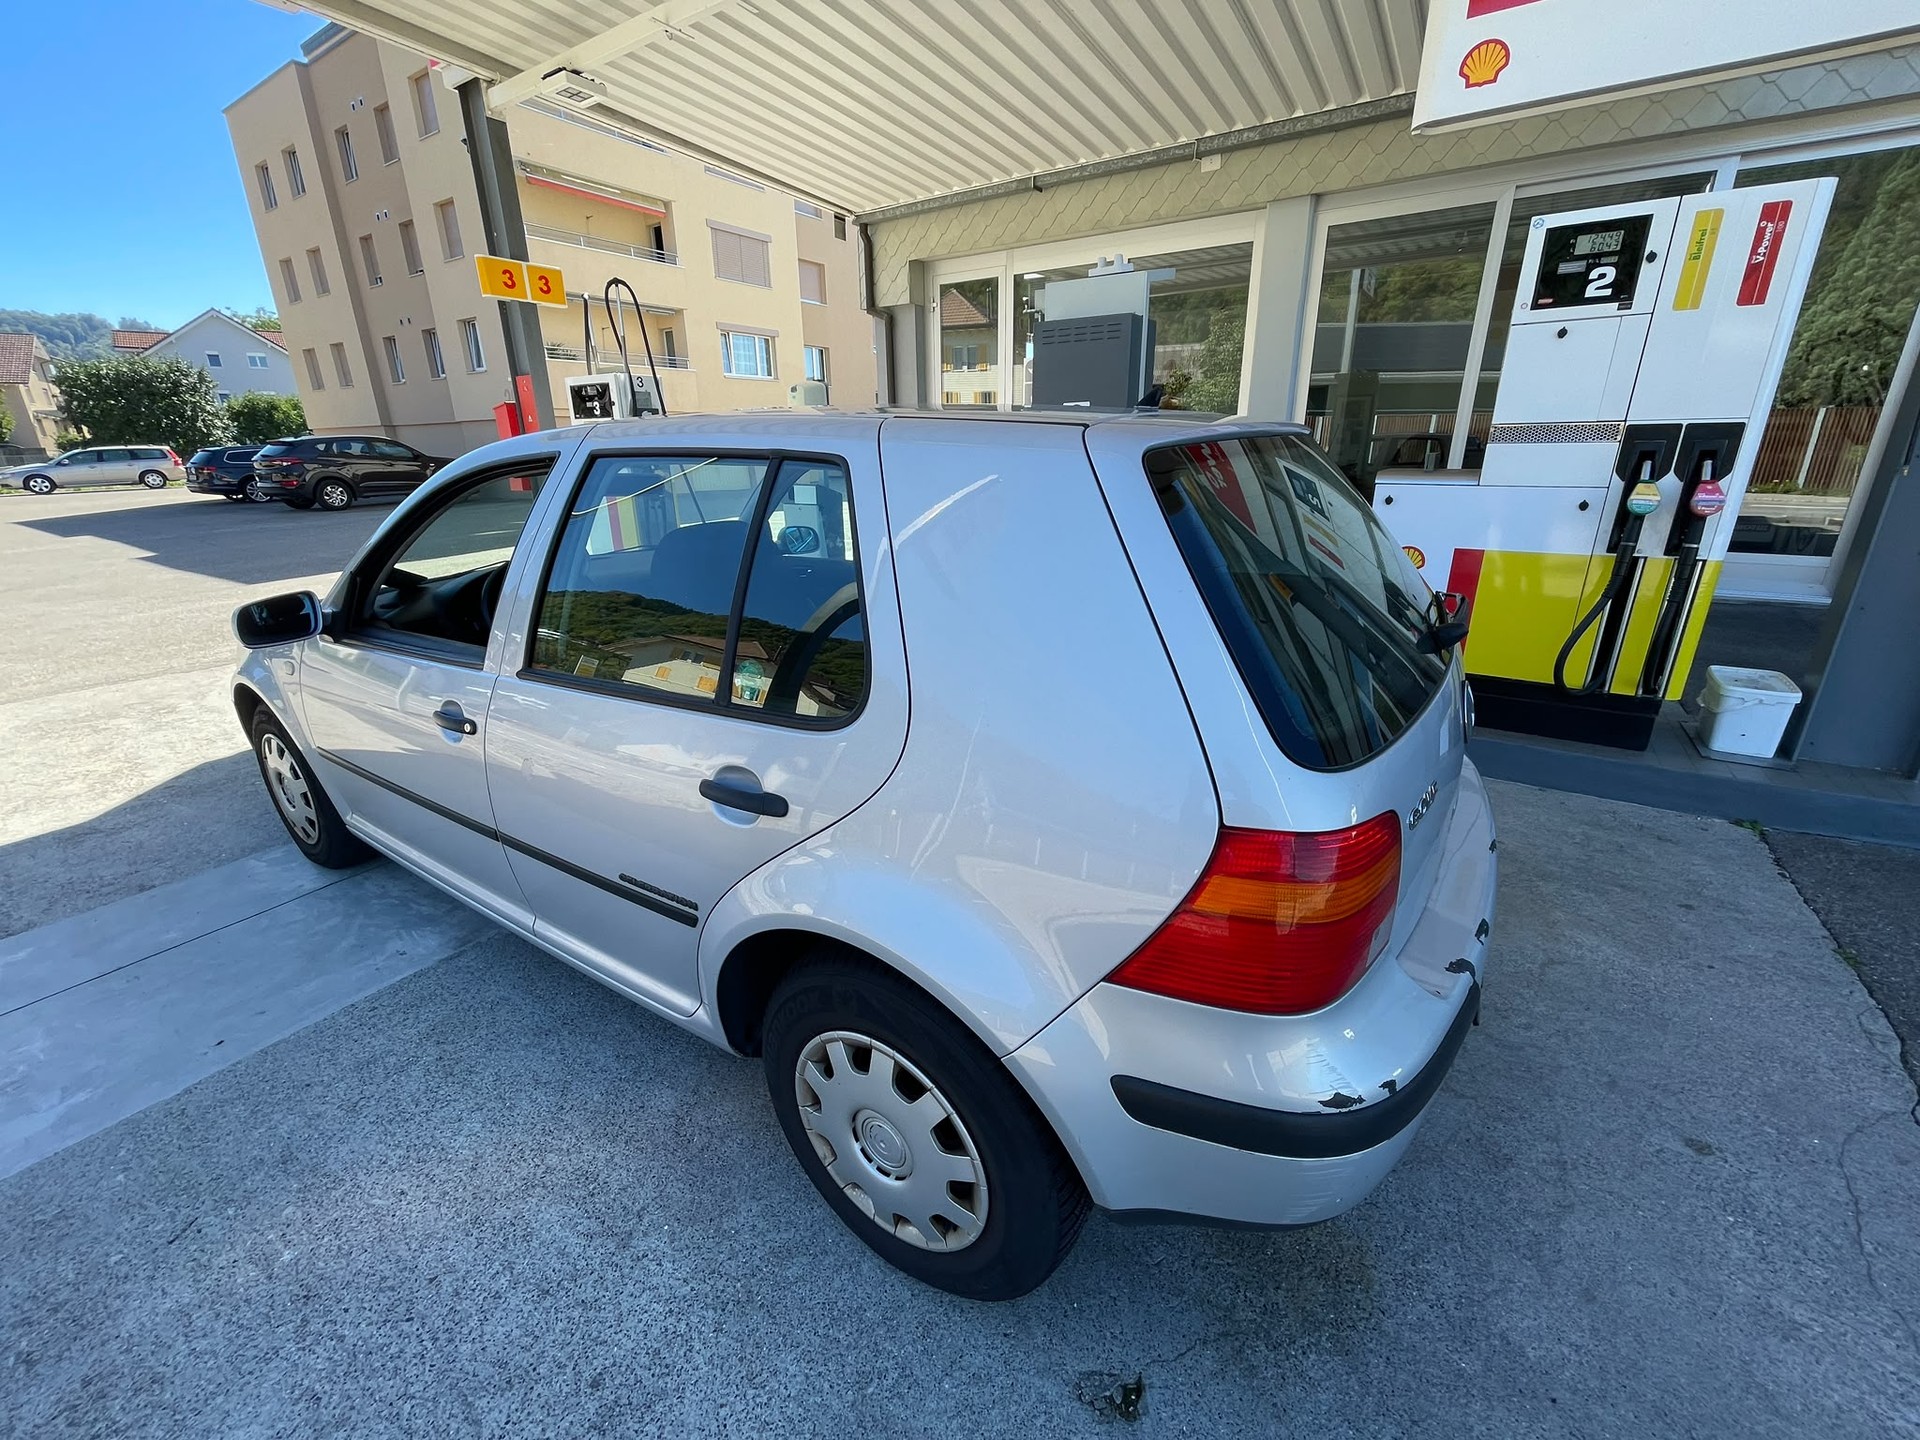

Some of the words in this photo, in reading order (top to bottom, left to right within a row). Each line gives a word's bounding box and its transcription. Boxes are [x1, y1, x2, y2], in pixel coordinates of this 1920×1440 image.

[1692, 229, 1708, 260] Bleifrei
[1754, 222, 1774, 263] V-Power
[502, 269, 516, 289] 3
[538, 275, 552, 294] 3
[1584, 265, 1617, 298] 2
[637, 376, 644, 388] 3
[593, 401, 600, 415] 3
